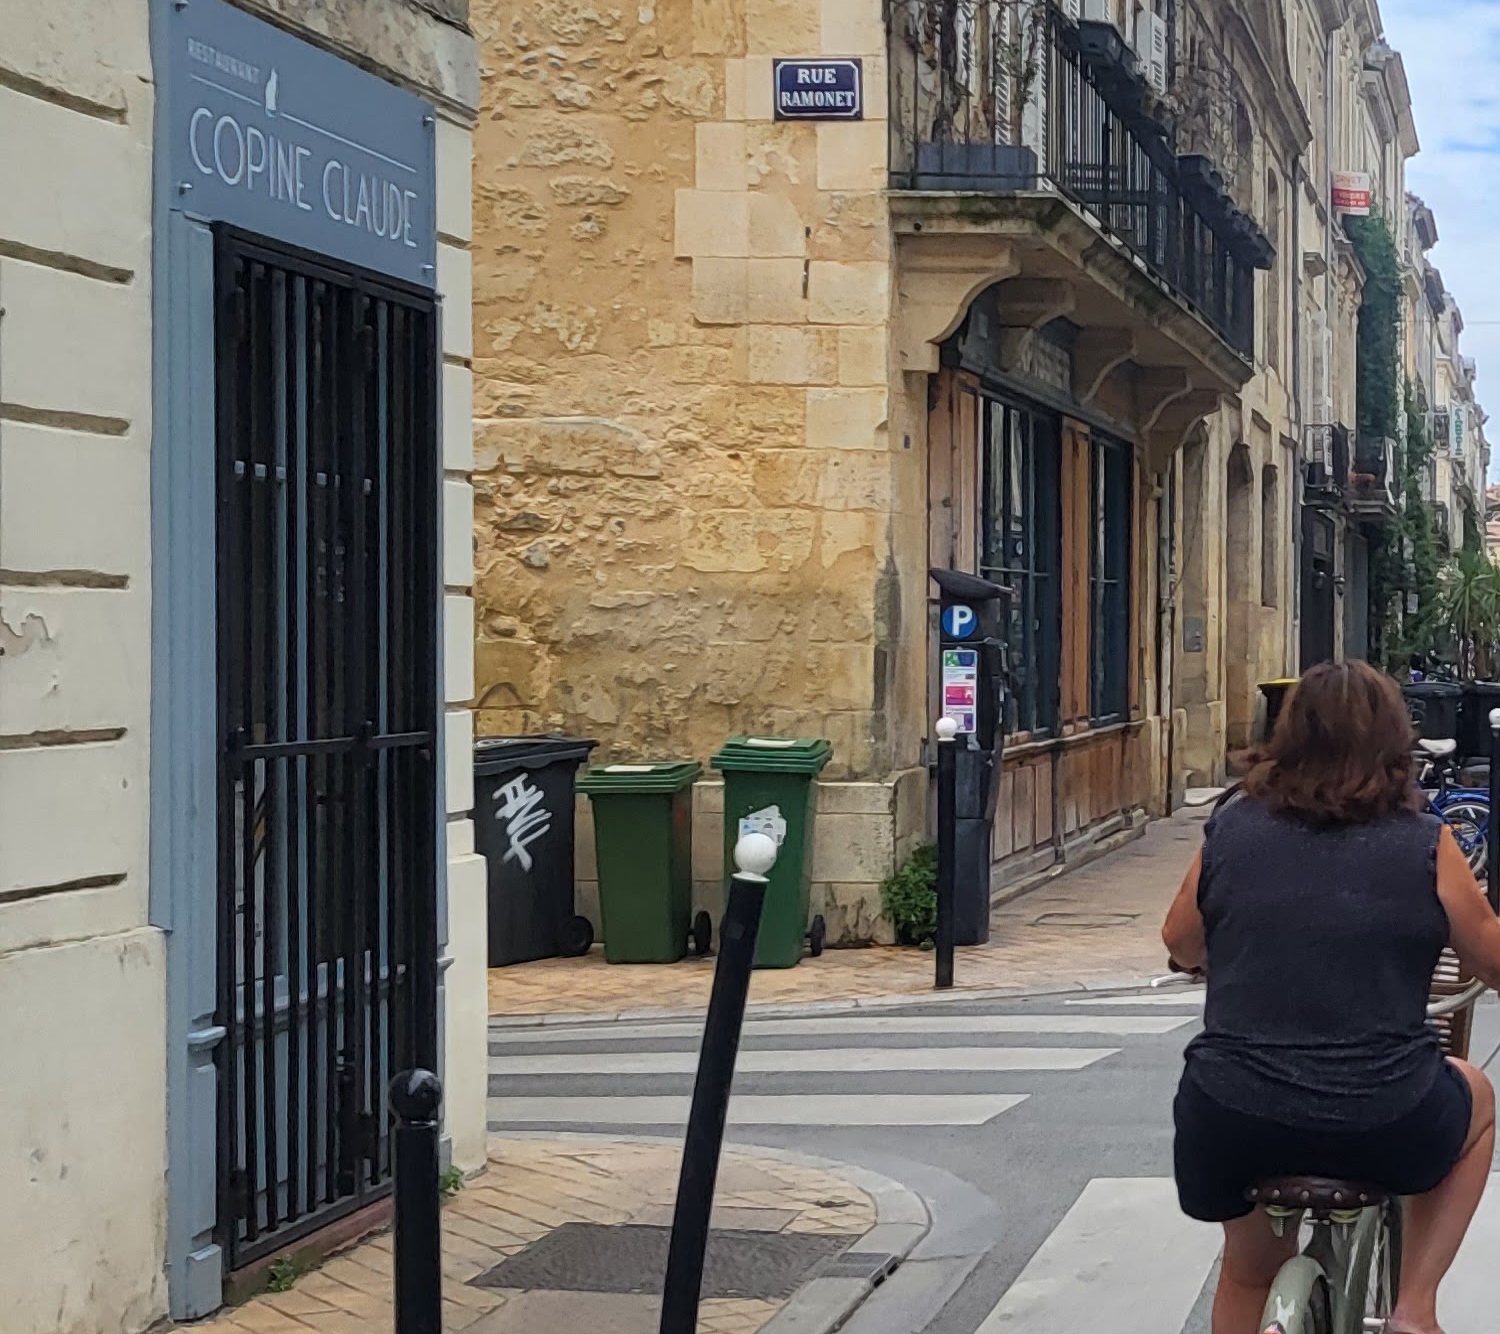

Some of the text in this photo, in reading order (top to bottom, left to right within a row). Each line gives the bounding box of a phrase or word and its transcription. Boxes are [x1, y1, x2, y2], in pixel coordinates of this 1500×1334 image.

[797, 68, 837, 84] RUE
[781, 91, 855, 107] RAMONET
[189, 107, 418, 248] COPINE CLAUDE
[952, 605, 973, 636] P
